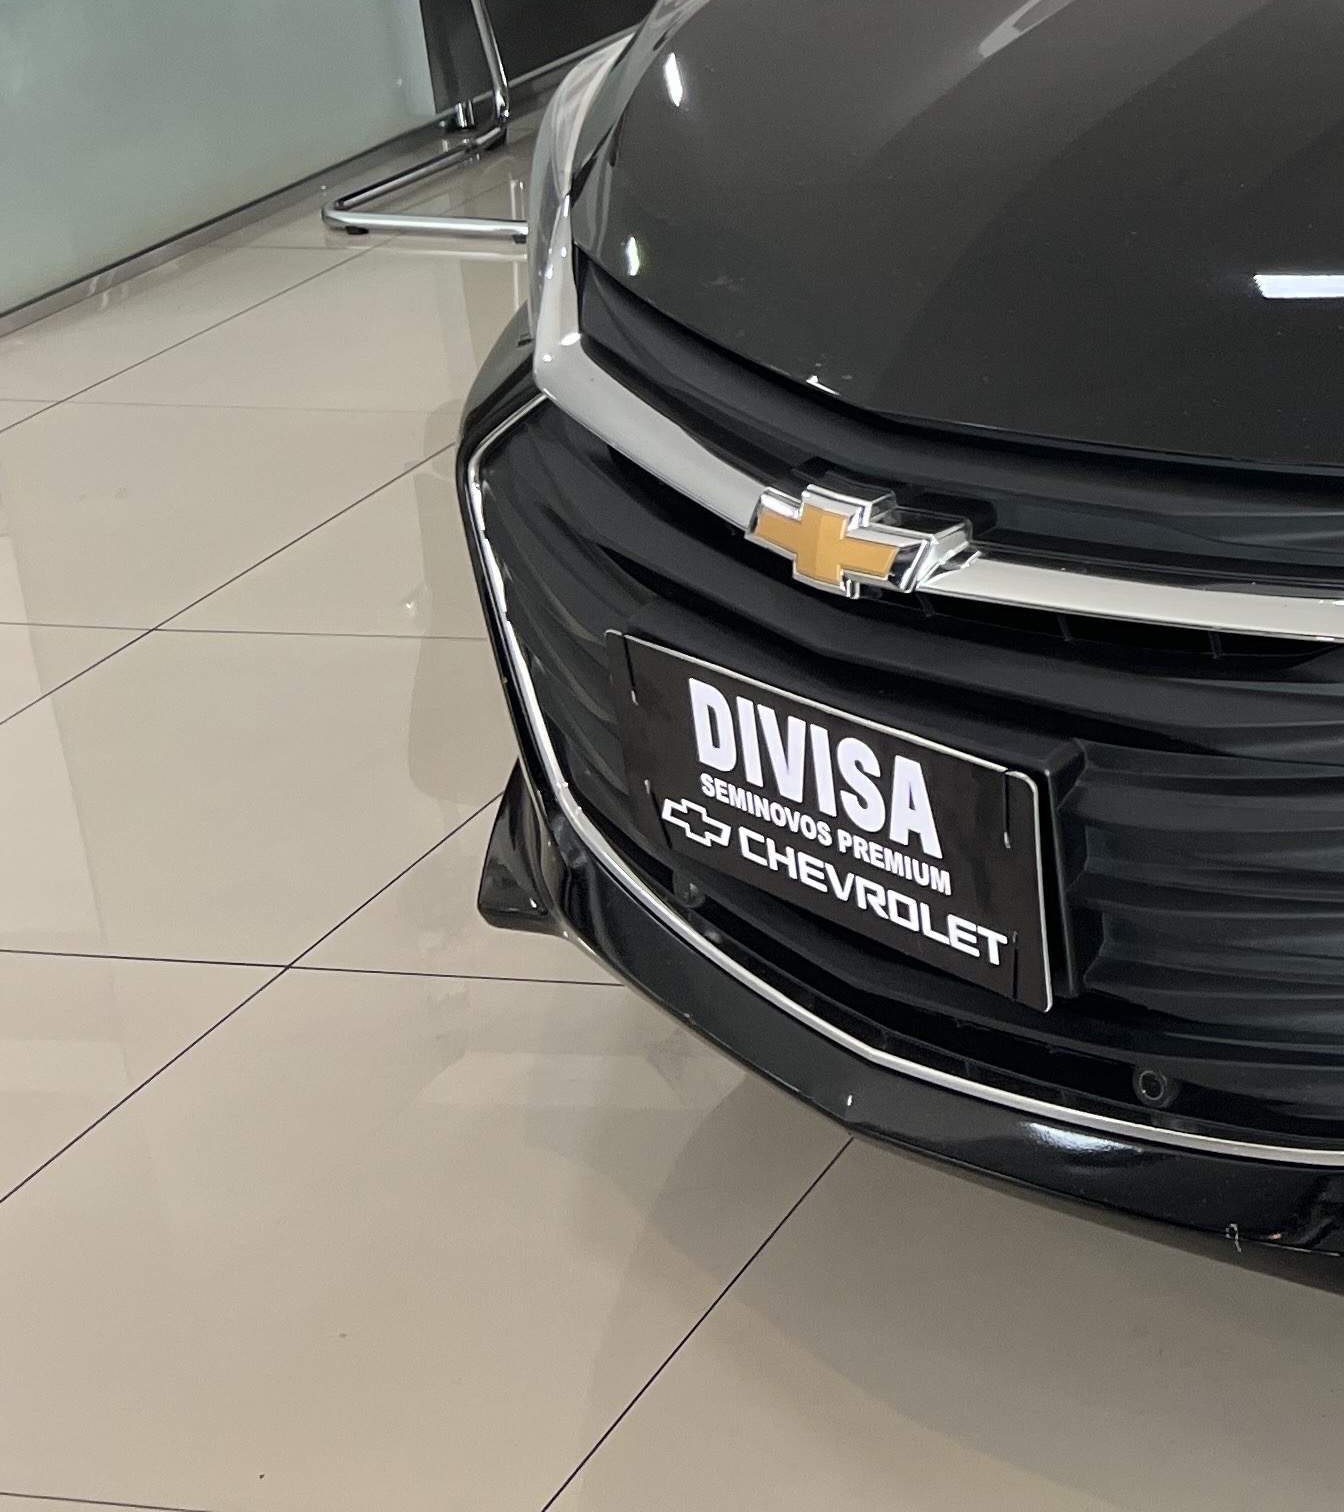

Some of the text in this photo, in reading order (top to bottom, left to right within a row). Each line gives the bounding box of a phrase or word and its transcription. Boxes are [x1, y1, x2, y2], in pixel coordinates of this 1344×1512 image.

[689, 676, 943, 860] DIVISA
[700, 772, 952, 896] SEMINOVOS PREMIUM
[738, 825, 1009, 966] CHEVROLET
